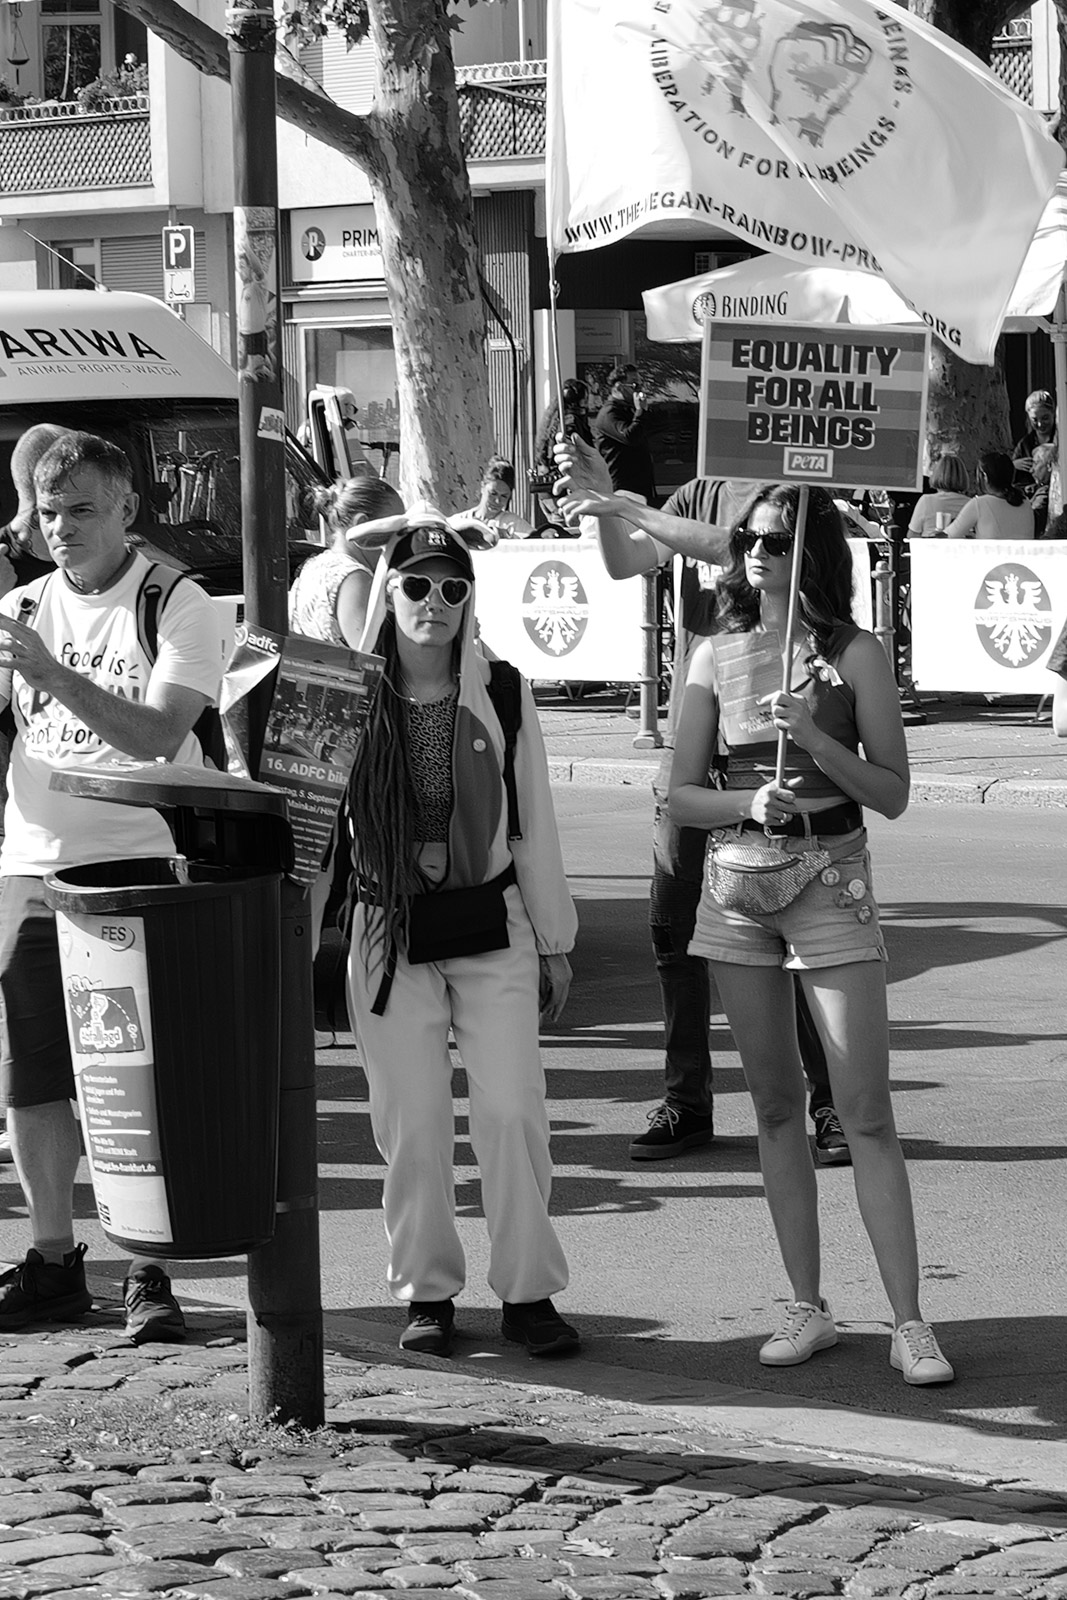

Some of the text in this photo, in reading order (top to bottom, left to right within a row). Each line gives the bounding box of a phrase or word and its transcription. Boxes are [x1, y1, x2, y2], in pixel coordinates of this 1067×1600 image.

[651, 38, 735, 159] LIBERATION
[737, 151, 790, 178] FOR
[169, 232, 187, 266] P
[722, 290, 789, 318] BINDING
[0, 328, 168, 361] ARIWA
[731, 338, 901, 377] EQUALITY
[17, 362, 182, 377] ANIMAL RIGHTS WATCH
[745, 375, 880, 413] FOR ALL
[747, 411, 876, 450] BEINGS
[60, 642, 126, 676] food is
[247, 632, 279, 653] adfc
[266, 757, 287, 773] 16.
[288, 762, 326, 781] ADFC
[101, 925, 127, 942] FES
